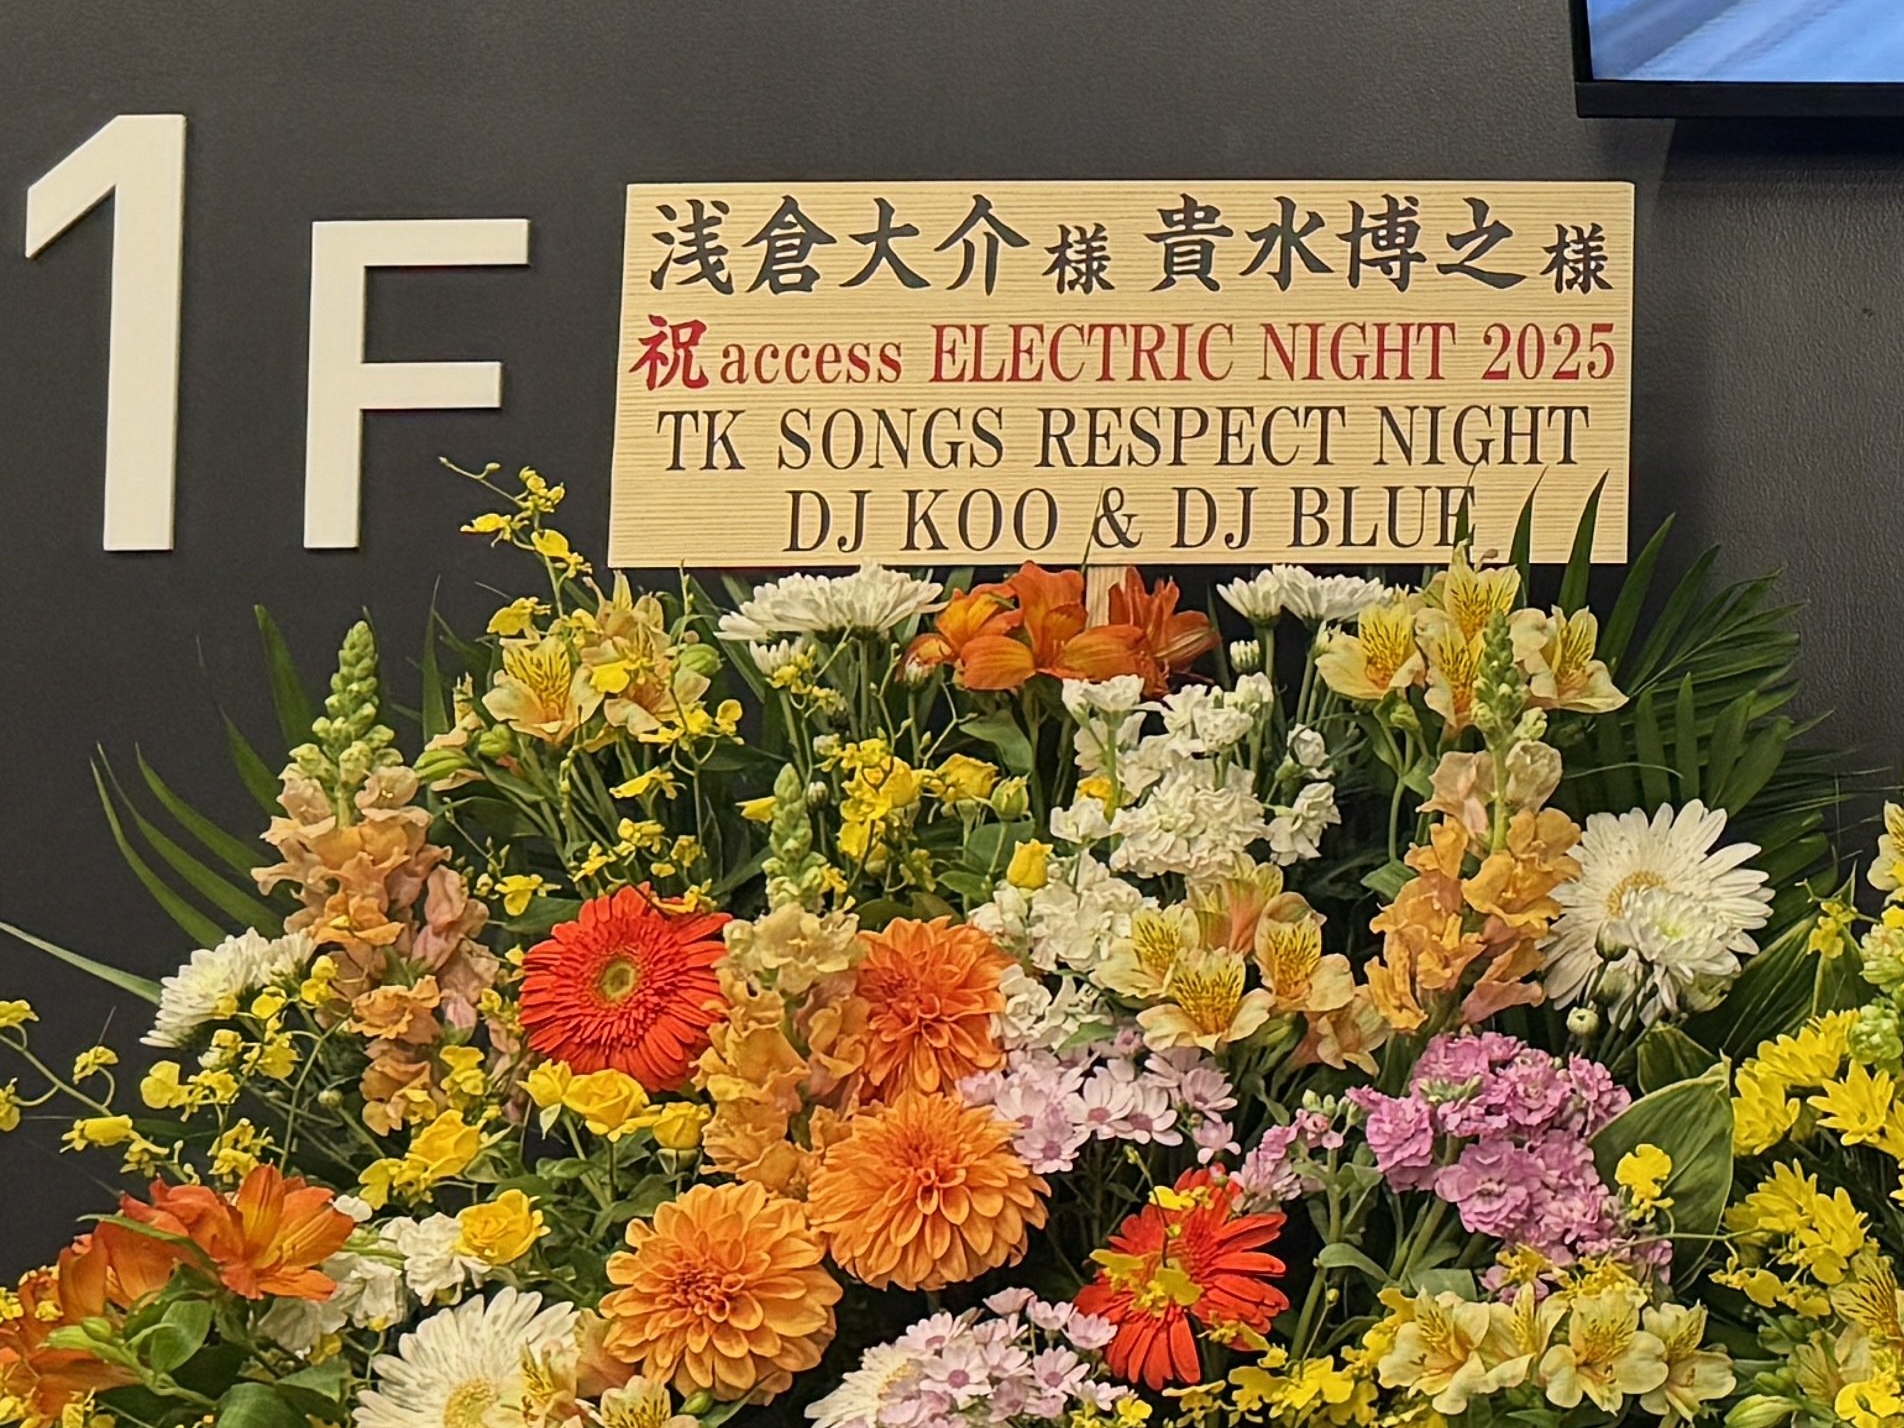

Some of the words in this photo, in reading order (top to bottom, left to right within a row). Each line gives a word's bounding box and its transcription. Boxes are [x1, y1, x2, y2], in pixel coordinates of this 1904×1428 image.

[649, 193, 1116, 296] 浅倉大介様
[1144, 193, 1614, 295] 貴水博之様
[931, 323, 1236, 384] ELECTRIC
[1259, 322, 1459, 386] NIGHT
[1483, 319, 1615, 382] 2025
[656, 409, 750, 471] TK
[777, 406, 1004, 470] SONGS
[1034, 405, 1346, 468] RESPECT
[1373, 404, 1590, 469] NIGHT
[782, 489, 868, 554] DJ
[900, 487, 1058, 552] KOO
[1091, 486, 1143, 550] &
[1170, 486, 1268, 550] DJ
[1289, 486, 1478, 550] BLUE
